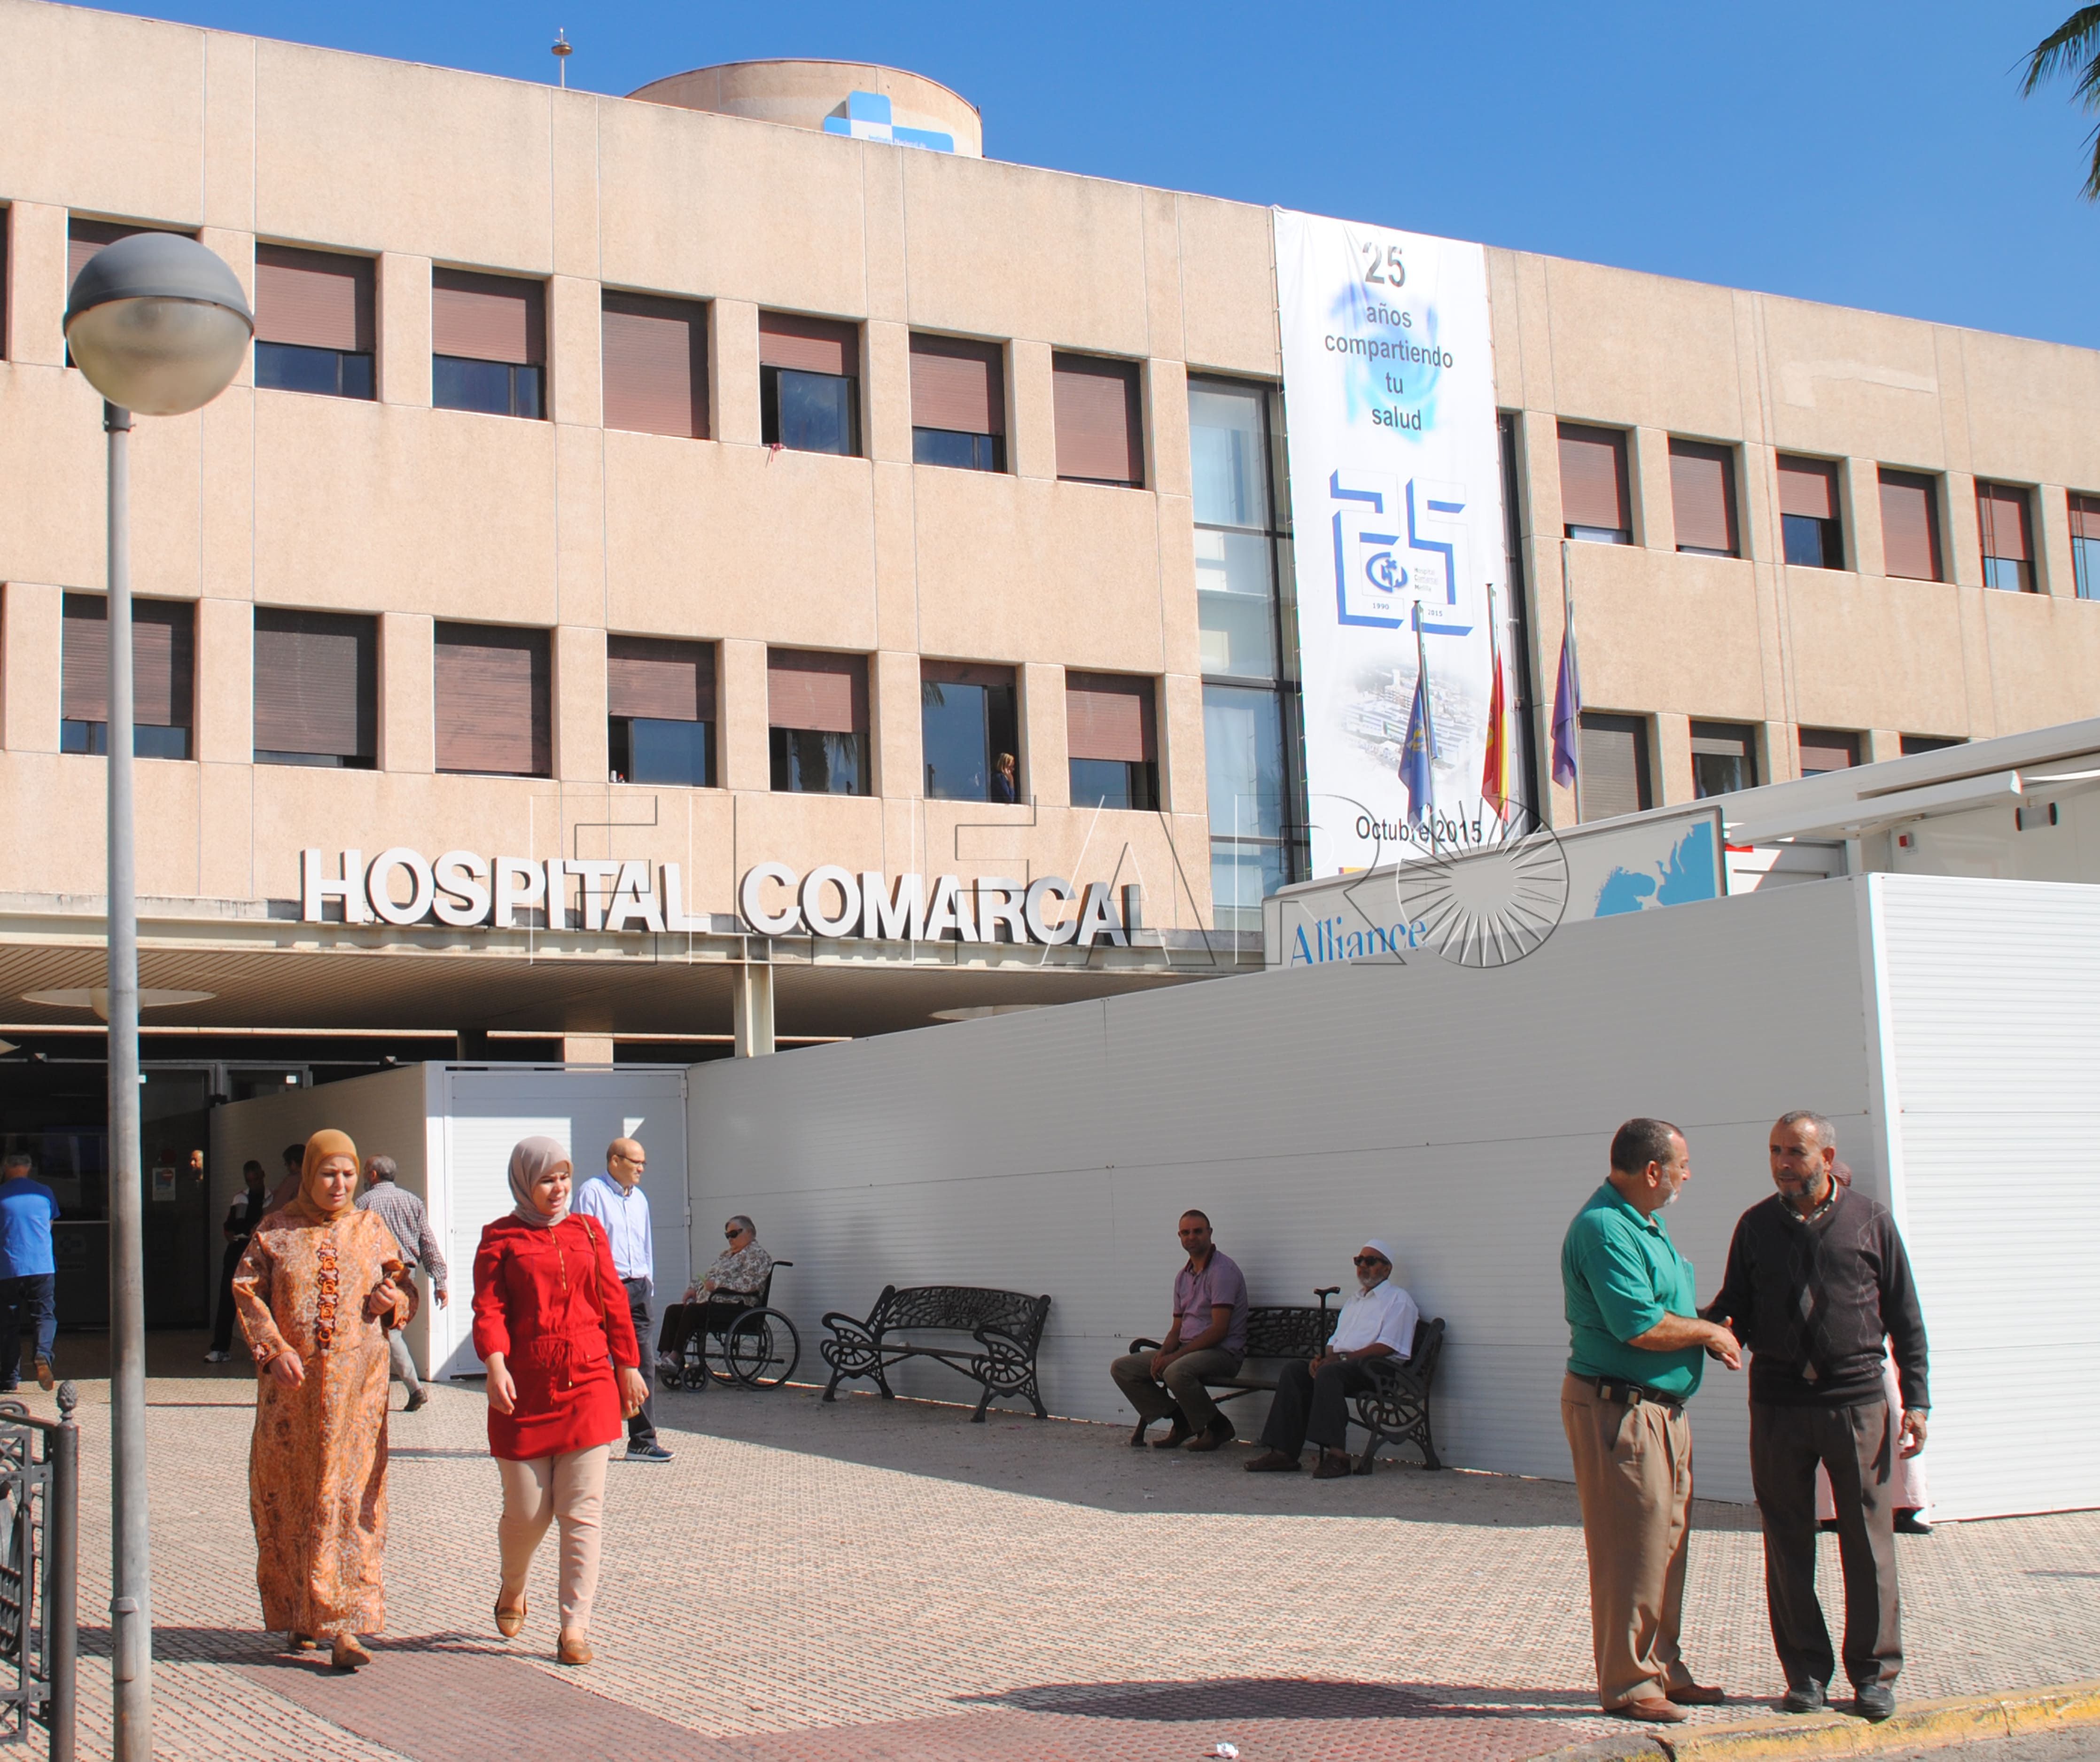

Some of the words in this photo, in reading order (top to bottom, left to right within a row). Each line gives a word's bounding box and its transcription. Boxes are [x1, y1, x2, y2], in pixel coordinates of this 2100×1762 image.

[1362, 242, 1406, 287] 25
[1366, 303, 1412, 328] años
[1324, 334, 1453, 368] compartiendo
[1385, 372, 1403, 394] tu
[1371, 406, 1422, 431] salud
[1356, 816, 1429, 841] Octubre
[1436, 819, 1482, 843] 2015
[302, 847, 712, 933] HOSPITAL
[738, 861, 1158, 947] COMARCAL
[1291, 916, 1427, 967] Alliance
